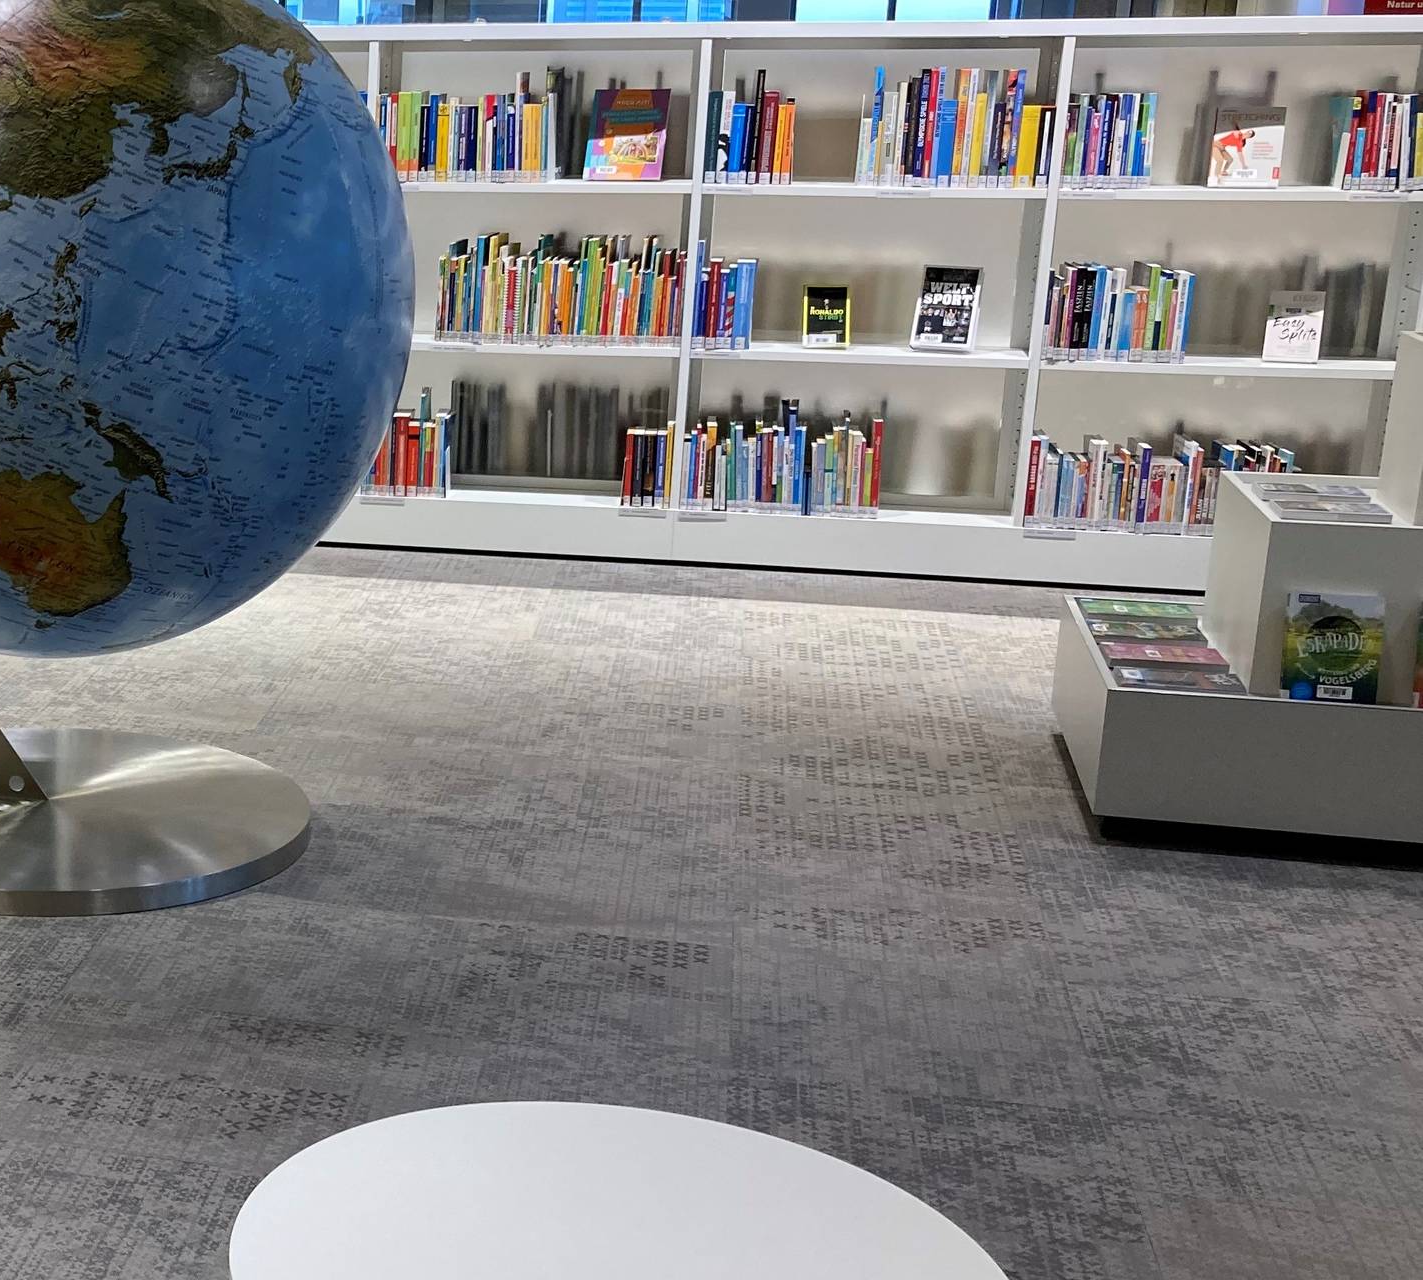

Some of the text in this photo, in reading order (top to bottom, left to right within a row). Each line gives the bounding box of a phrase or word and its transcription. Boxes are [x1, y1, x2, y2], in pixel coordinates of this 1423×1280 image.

[1386, 0, 1416, 9] Natur
[929, 281, 971, 295] WELT
[923, 292, 974, 307] SPORT
[809, 305, 844, 316] RONALDO
[1273, 316, 1305, 332] Easy
[1279, 327, 1317, 344] Splits
[1296, 631, 1376, 658] ESKAPADEN
[1318, 658, 1378, 686] VOGELSBERG
